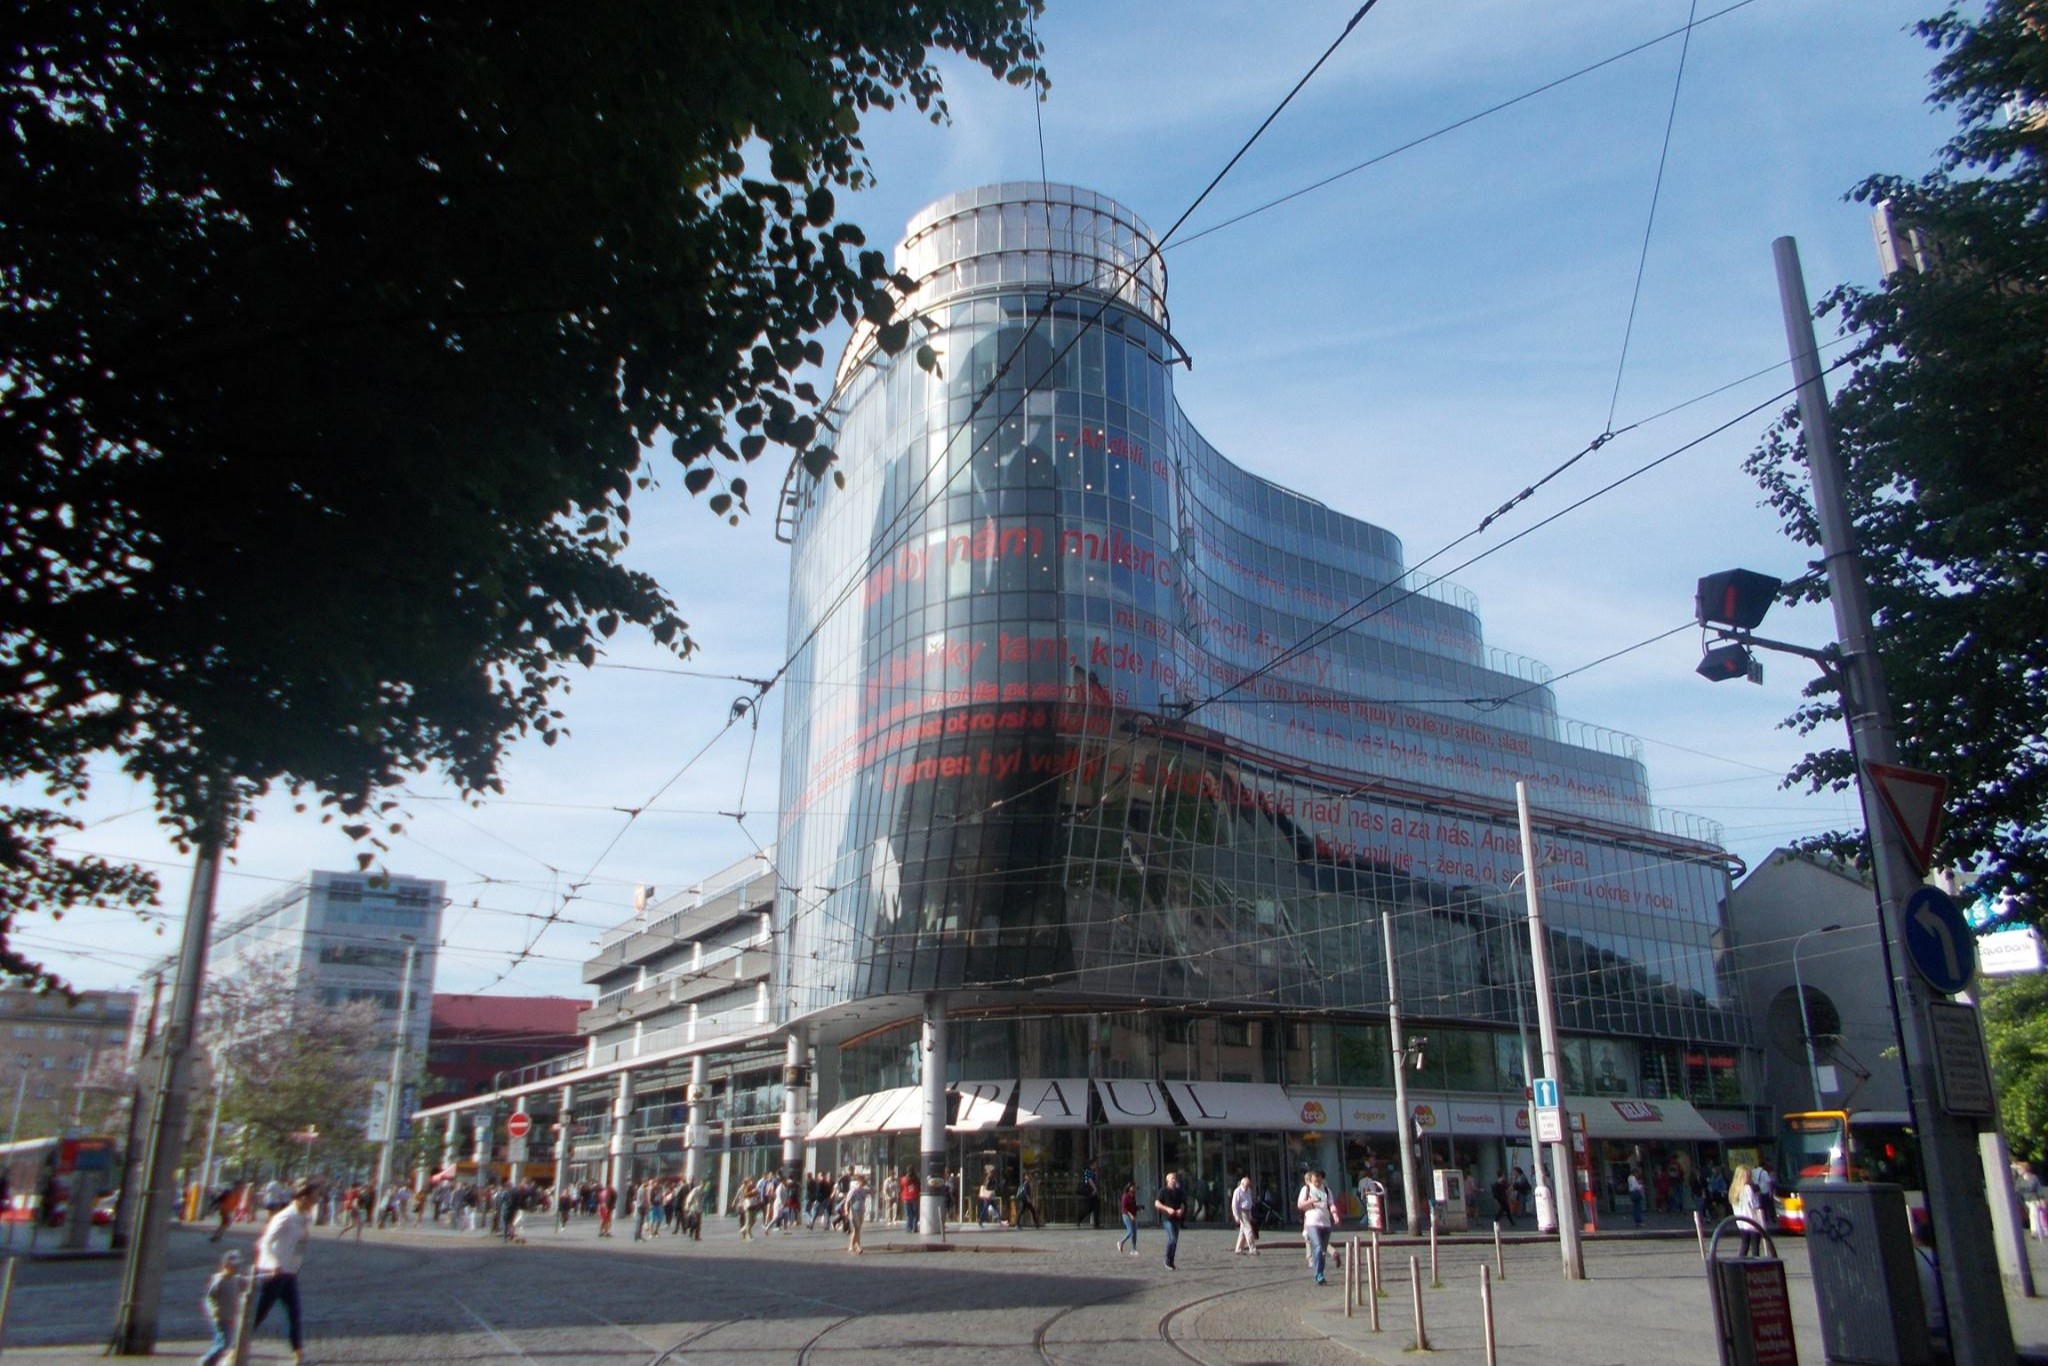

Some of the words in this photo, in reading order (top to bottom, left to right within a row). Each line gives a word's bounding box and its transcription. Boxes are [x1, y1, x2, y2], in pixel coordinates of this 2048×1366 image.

[998, 632, 1077, 669] tam,
[1091, 636, 1144, 674] kde
[1116, 608, 1138, 628] na
[1402, 713, 1449, 736] rozleu
[1302, 798, 1341, 825] nad
[1391, 816, 1403, 835] a
[1409, 820, 1430, 840] za
[1584, 880, 1592, 897] u
[1596, 881, 1630, 904] okna
[1646, 892, 1673, 910] noci
[961, 1080, 1228, 1121] PAUL
[1353, 1109, 1386, 1122] drogerie
[1617, 1100, 1653, 1119] RELAY
[1303, 1111, 1325, 1123] teta
[1456, 1112, 1494, 1124] kosmetika
